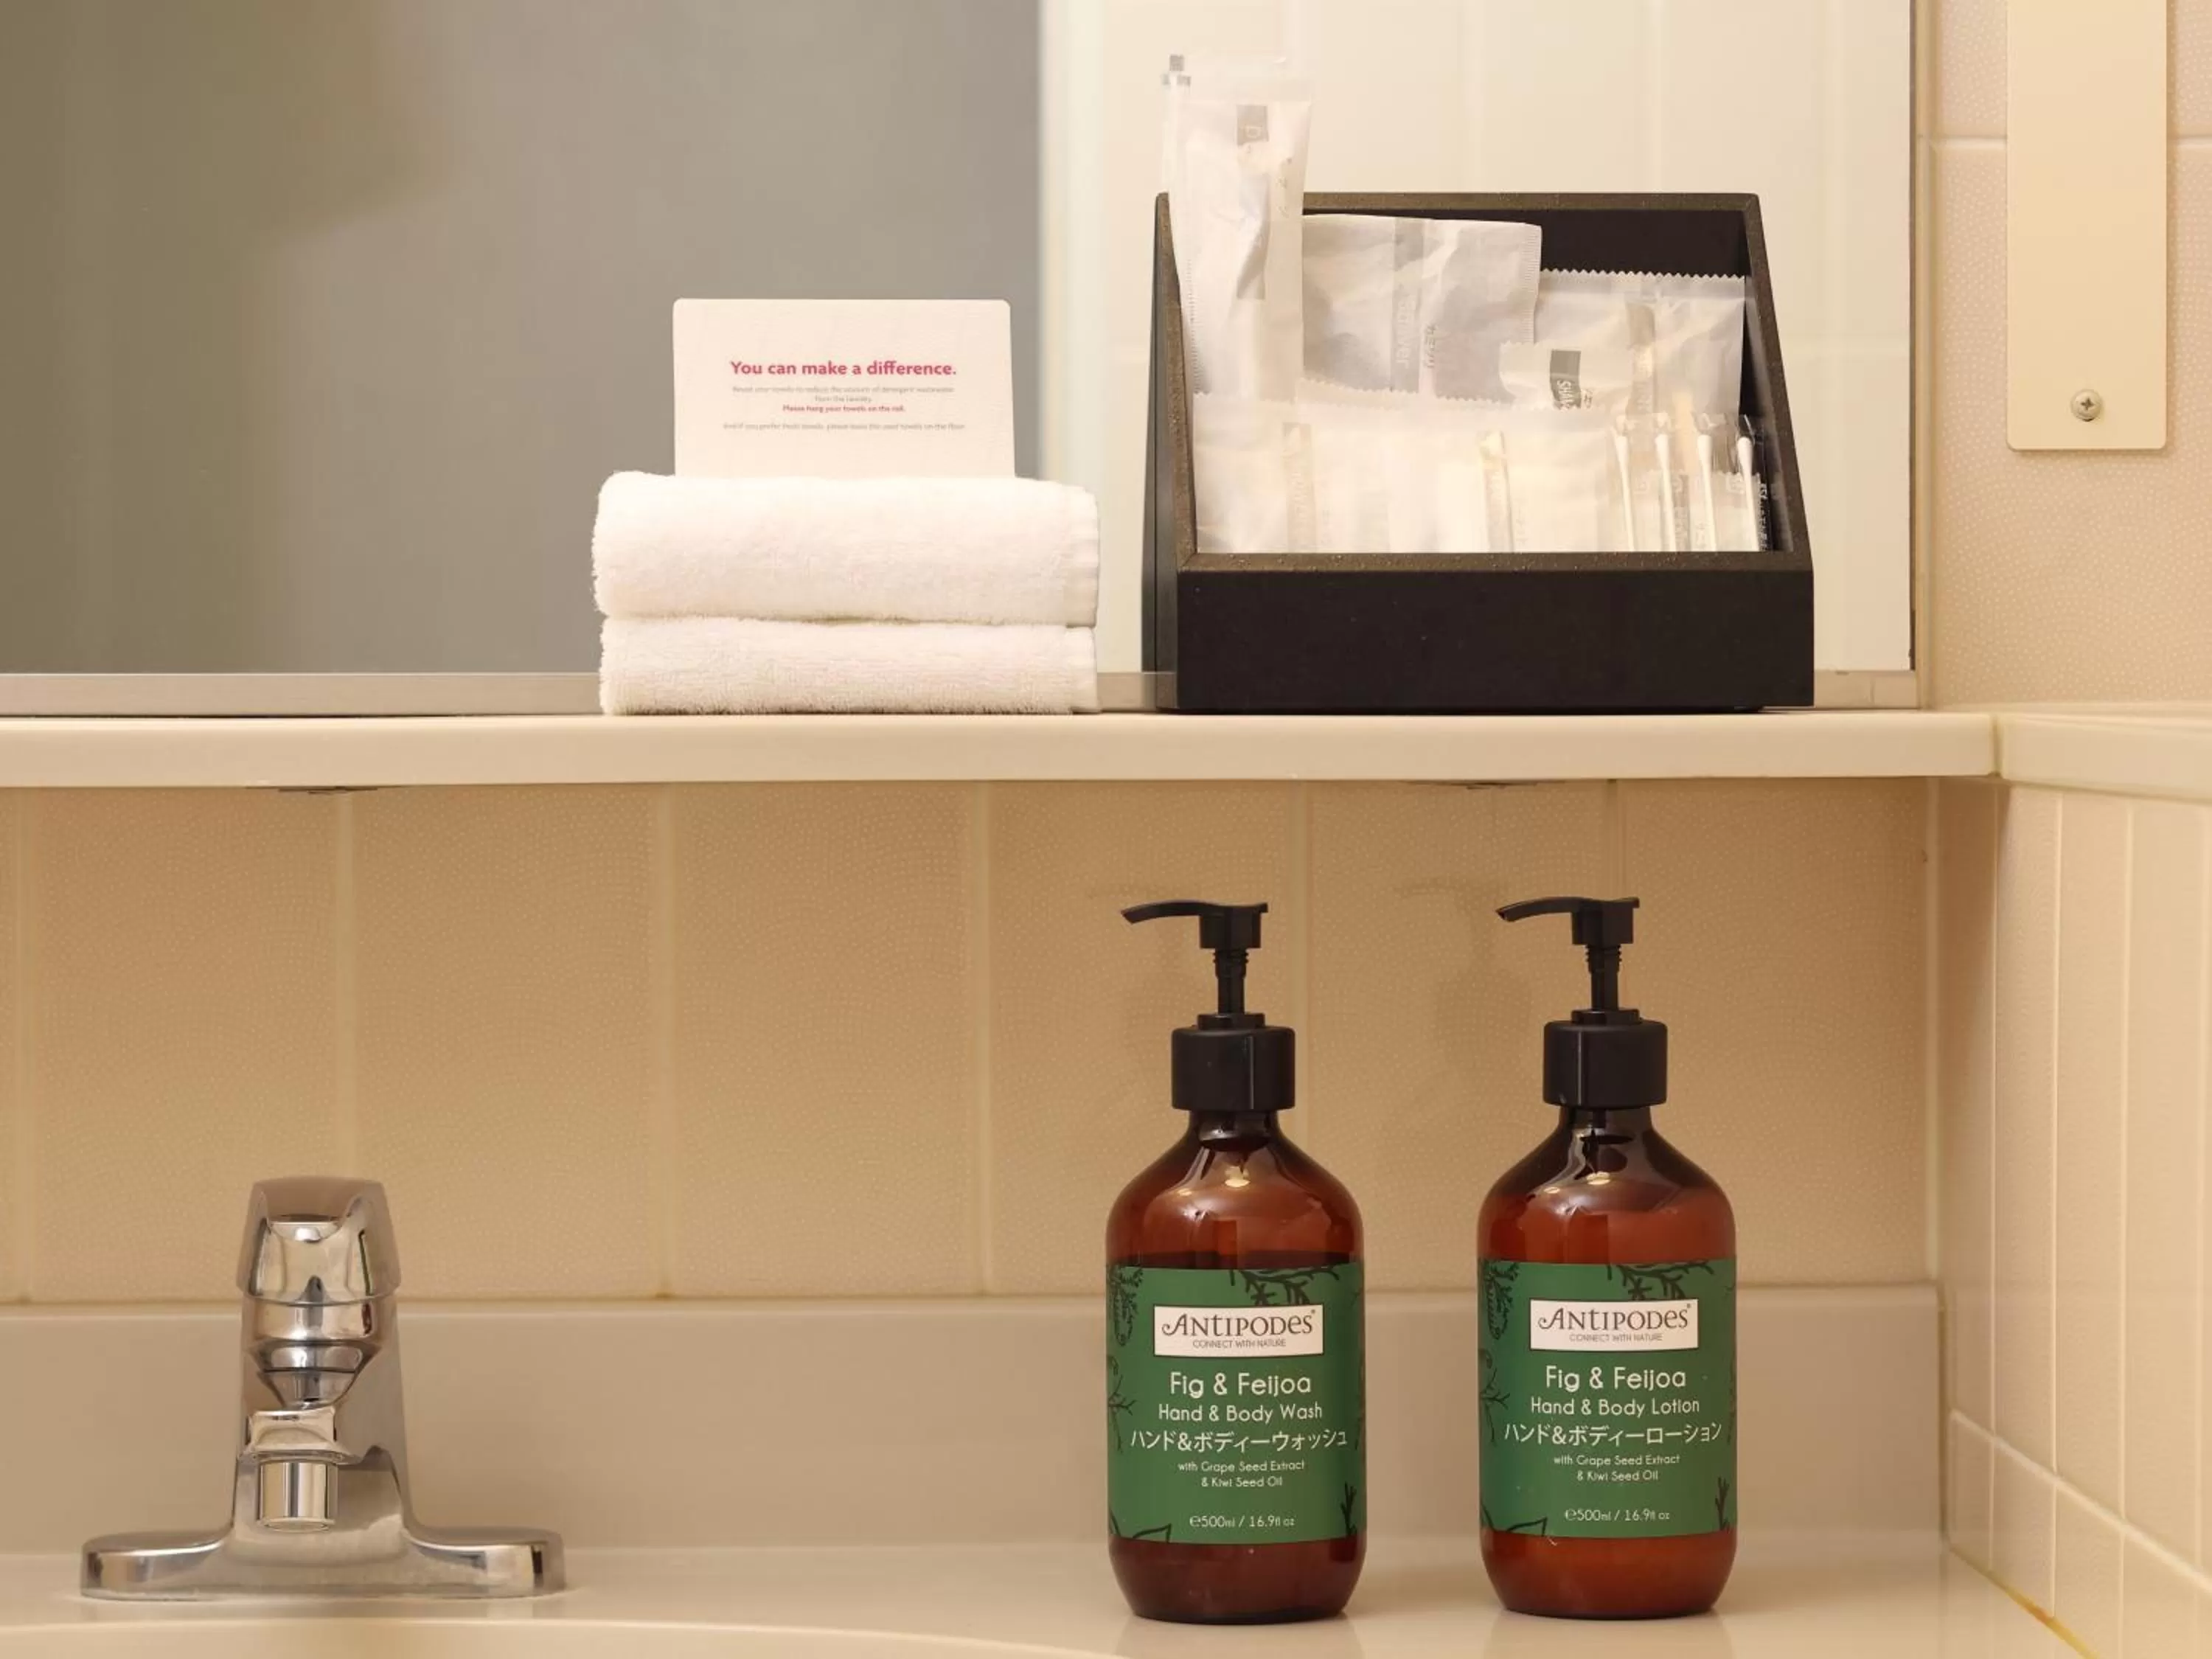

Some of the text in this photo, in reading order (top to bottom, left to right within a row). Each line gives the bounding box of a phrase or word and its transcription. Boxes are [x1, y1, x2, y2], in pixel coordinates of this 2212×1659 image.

[731, 360, 957, 375] You can make a difference.
[1192, 1338, 1287, 1349] CONNECT WITH NATURE
[1170, 1371, 1312, 1399] Fig & Feijoa
[1546, 1365, 1686, 1392] Fig & Feijoa
[1158, 1401, 1323, 1425] Hand & Body Wash
[1531, 1397, 1700, 1419] Hand & Body Lotion
[1178, 1459, 1305, 1475] with Grape Seed Extract
[1554, 1454, 1680, 1469] with Grape Seed Extract
[1201, 1475, 1283, 1487] & Kiwi Seed Oil
[1576, 1470, 1659, 1482] & Kiwi Seed Oil
